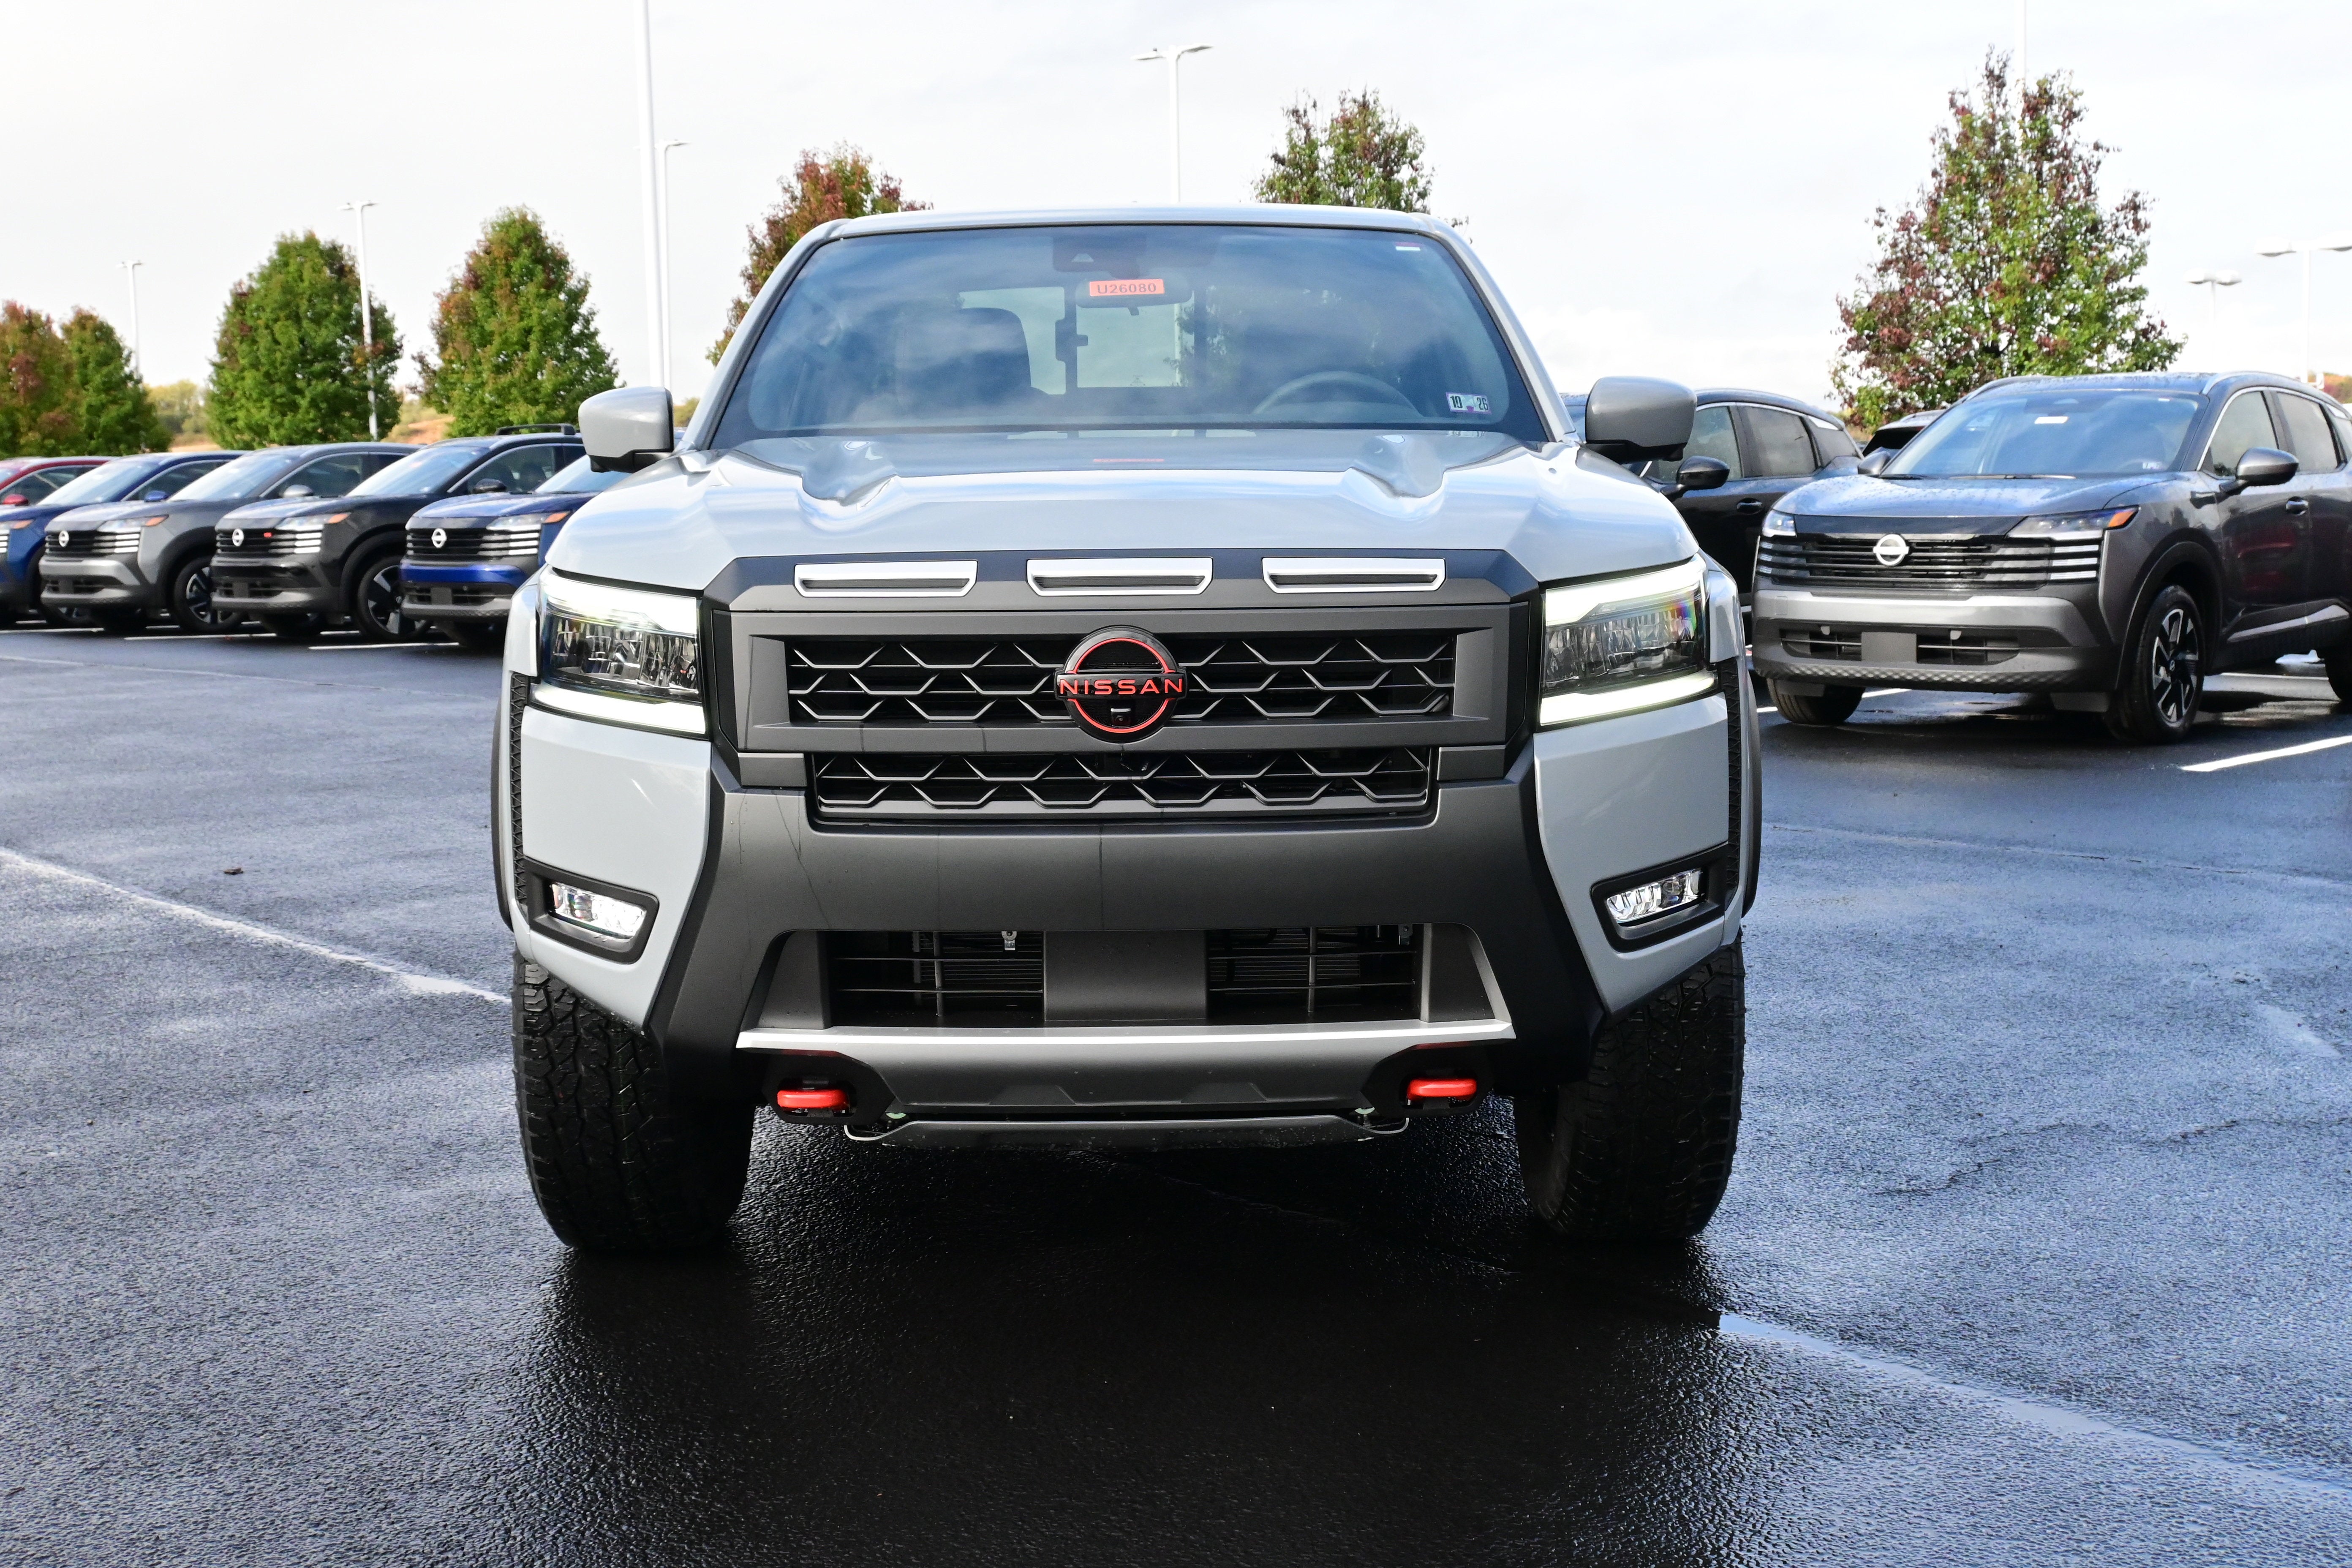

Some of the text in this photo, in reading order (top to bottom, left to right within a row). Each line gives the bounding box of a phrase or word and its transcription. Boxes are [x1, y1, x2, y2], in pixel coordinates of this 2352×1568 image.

[1097, 283, 1157, 294] U26080
[1450, 395, 1489, 411] 10 26
[1059, 678, 1182, 695] NISSAN
